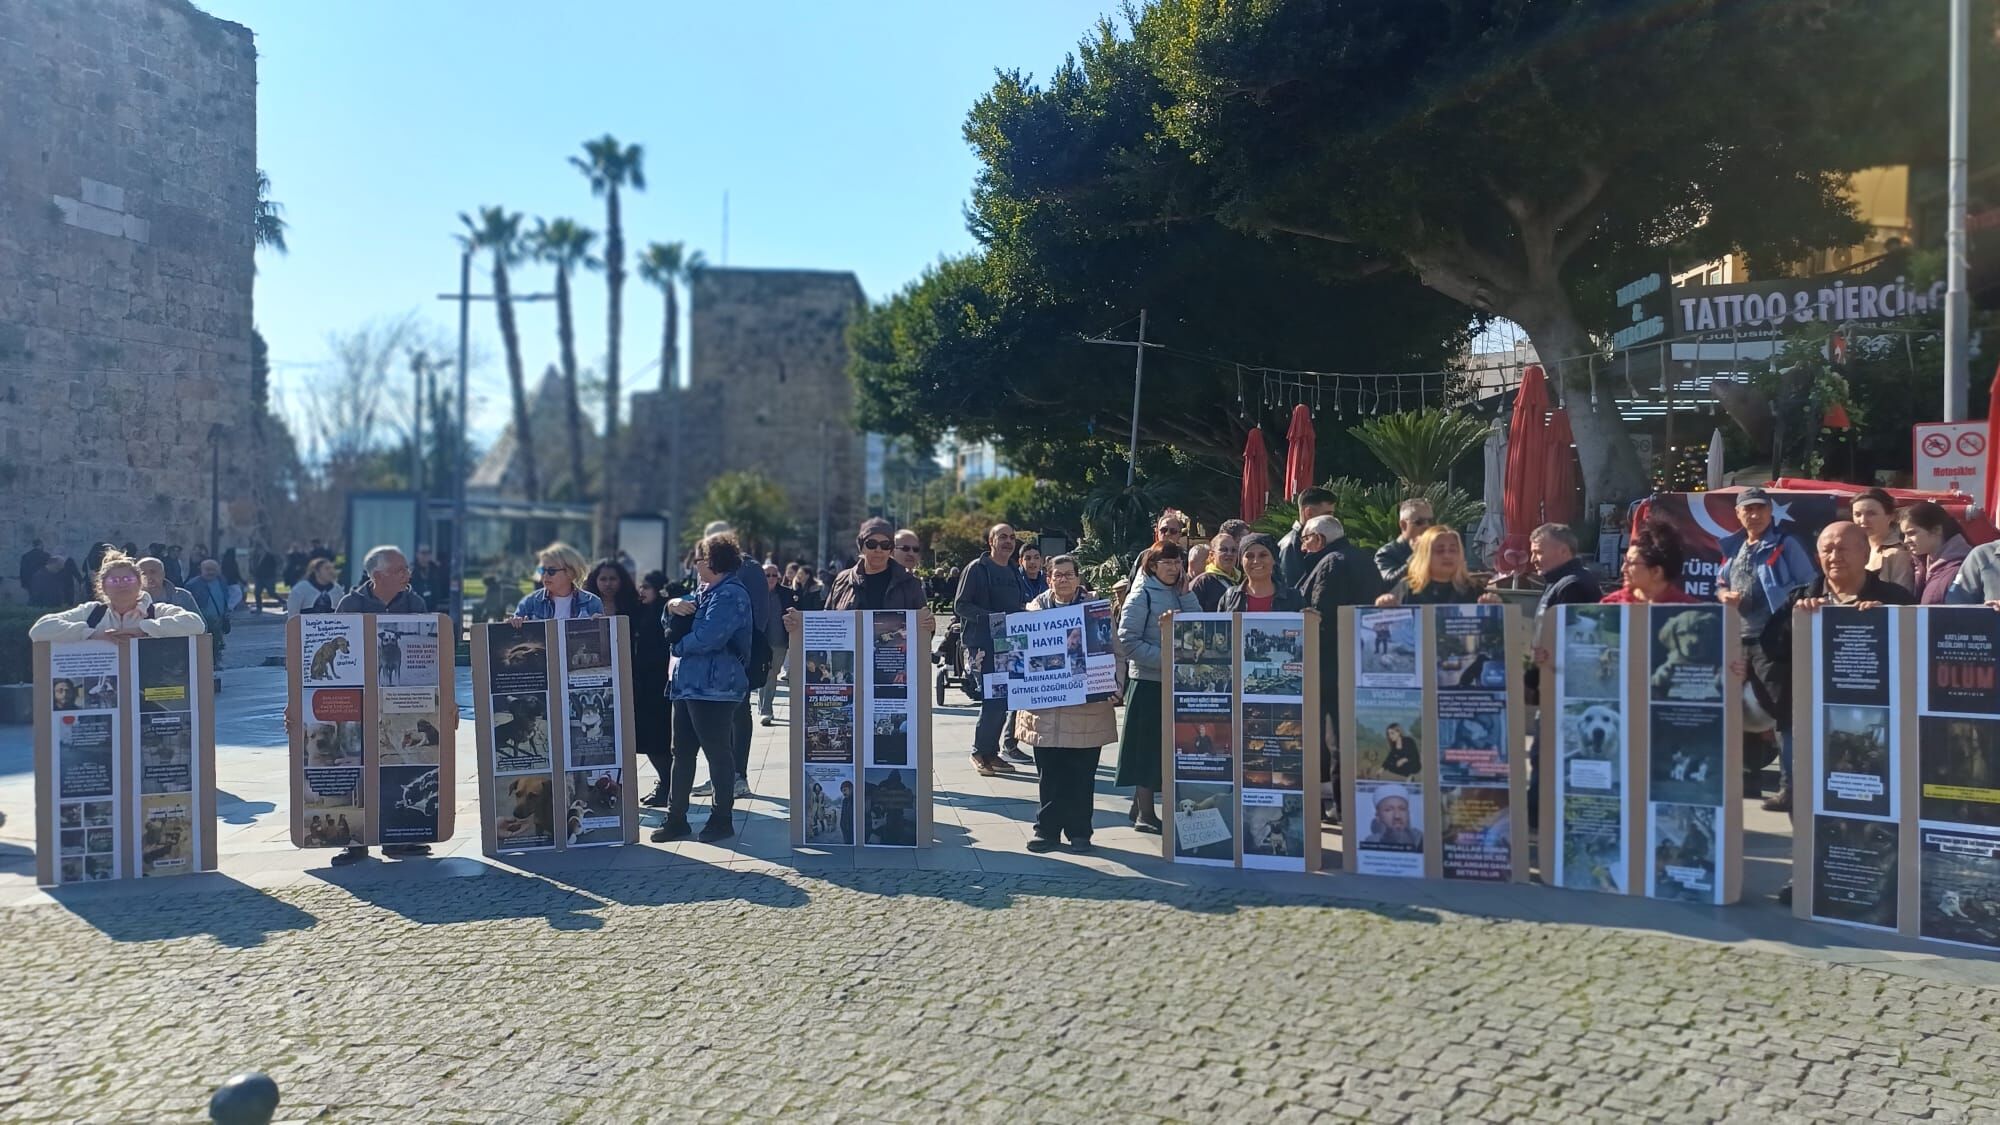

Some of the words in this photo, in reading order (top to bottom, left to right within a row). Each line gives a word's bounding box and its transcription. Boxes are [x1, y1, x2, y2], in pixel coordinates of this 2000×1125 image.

[1680, 291, 1787, 331] TATTOO
[1793, 291, 1814, 323] &
[1684, 581, 1710, 596] NE
[1010, 622, 1041, 634] KANLI
[1042, 616, 1082, 630] YASAYA
[1032, 636, 1064, 648] HAYIR
[1011, 685, 1039, 696] GİTMEK
[1040, 680, 1084, 693] ÖZGÜRLÜĞÜ
[1030, 694, 1067, 705] İSTİYORUZ
